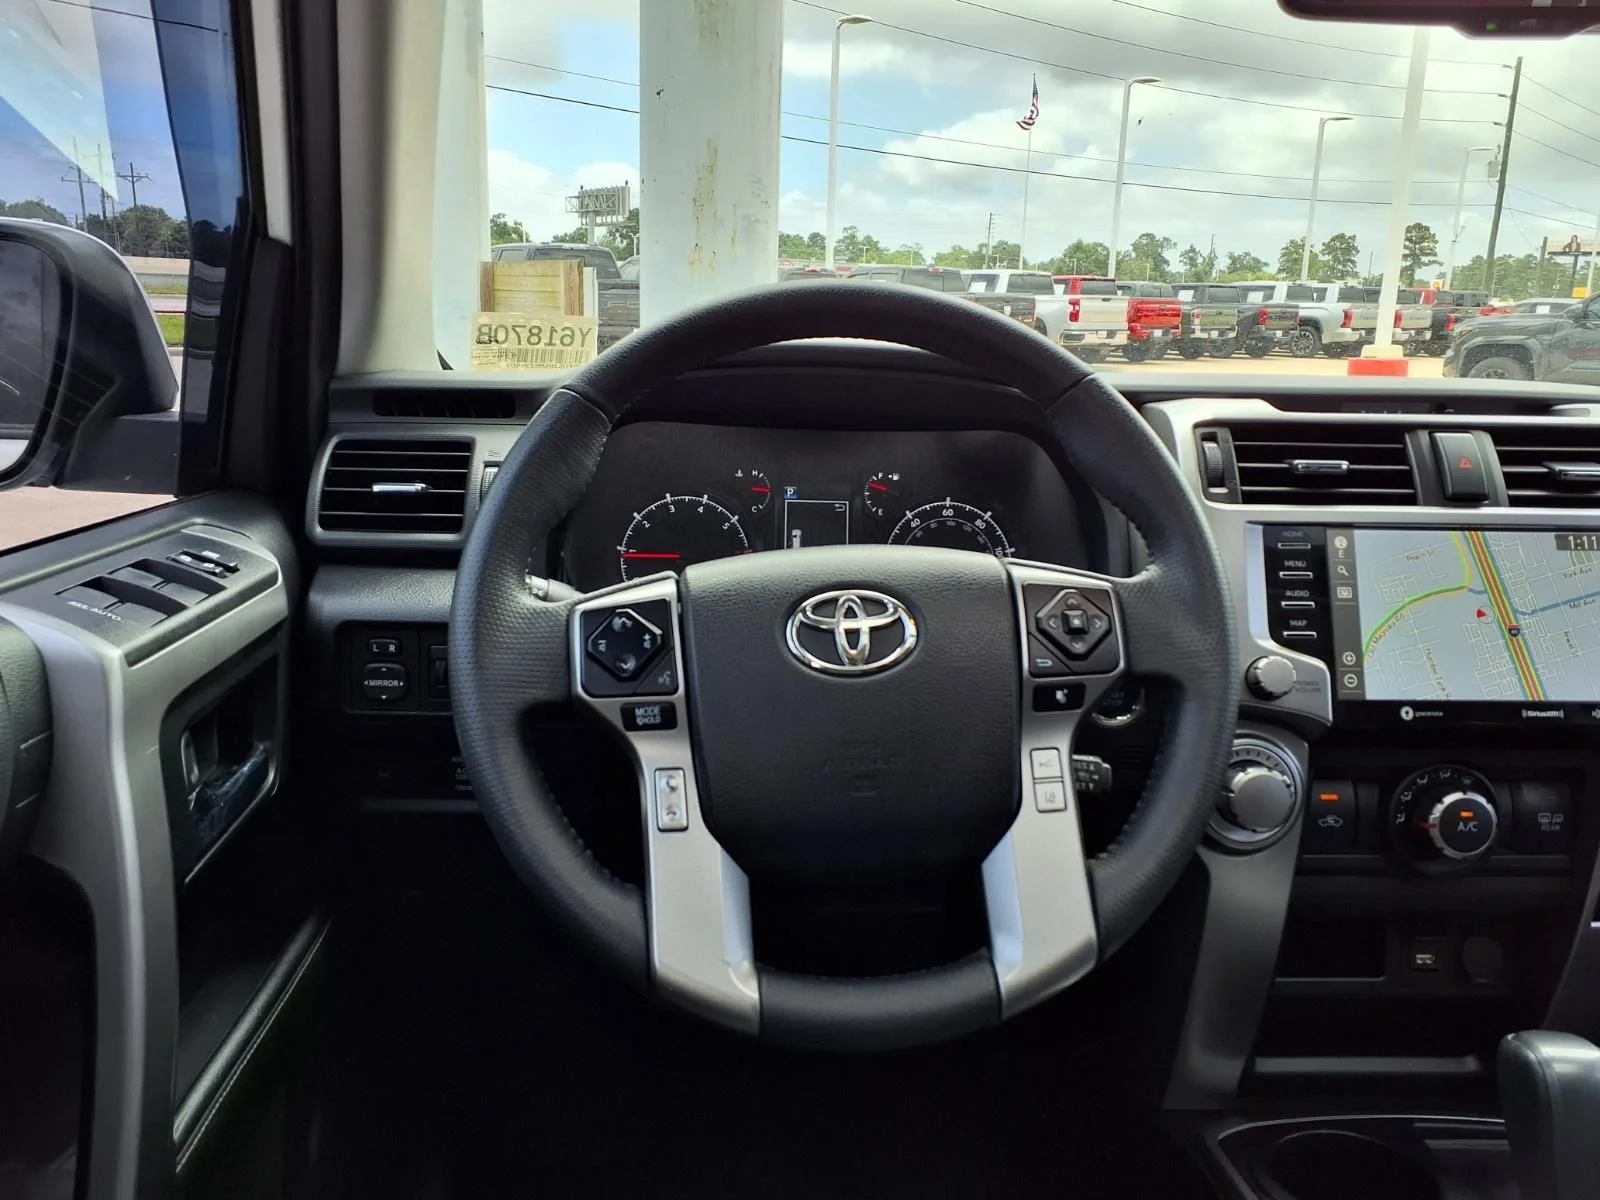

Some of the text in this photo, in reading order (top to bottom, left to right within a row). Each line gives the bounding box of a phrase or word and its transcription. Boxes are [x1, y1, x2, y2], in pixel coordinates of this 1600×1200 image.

[669, 505, 675, 513] 3
[697, 505, 704, 513] 4
[942, 508, 954, 516] 60
[642, 521, 651, 529] 2
[722, 522, 730, 530] 5
[910, 518, 921, 528] 40
[974, 519, 986, 530] 80
[1284, 560, 1307, 568] MENU
[1285, 589, 1310, 597] AUDIO
[67, 601, 122, 621] ALL AUTO
[1289, 619, 1308, 627] MAP
[373, 644, 396, 652] L R
[369, 679, 399, 687] MIRROR
[634, 705, 661, 716] MODE
[1457, 821, 1479, 832] A/C
